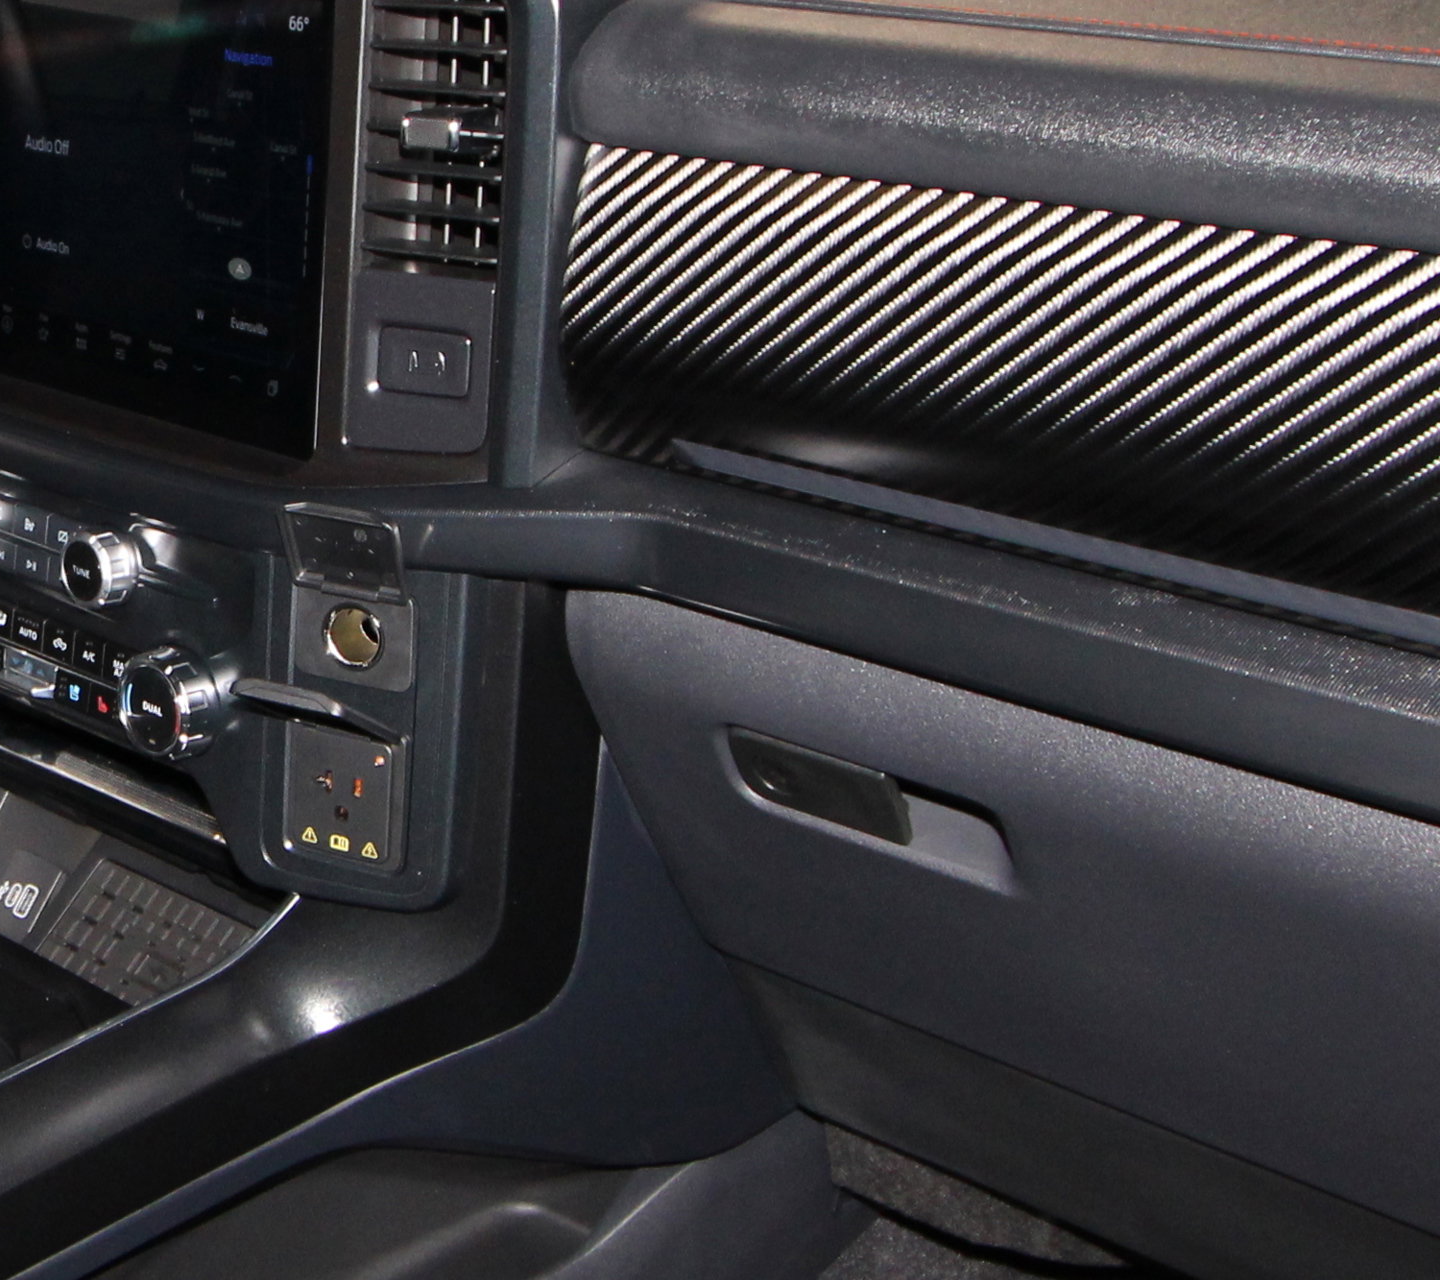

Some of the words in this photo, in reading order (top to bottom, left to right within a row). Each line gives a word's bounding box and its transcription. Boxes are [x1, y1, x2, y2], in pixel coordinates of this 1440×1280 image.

[224, 48, 273, 66] Navigation
[24, 133, 53, 153] Audio
[54, 139, 70, 156] Off
[36, 237, 58, 253] Audio
[58, 241, 70, 255] On
[73, 564, 91, 580] TUNE
[19, 626, 38, 641] AUTO
[82, 651, 97, 665] A/C
[142, 700, 163, 718] DUAL
